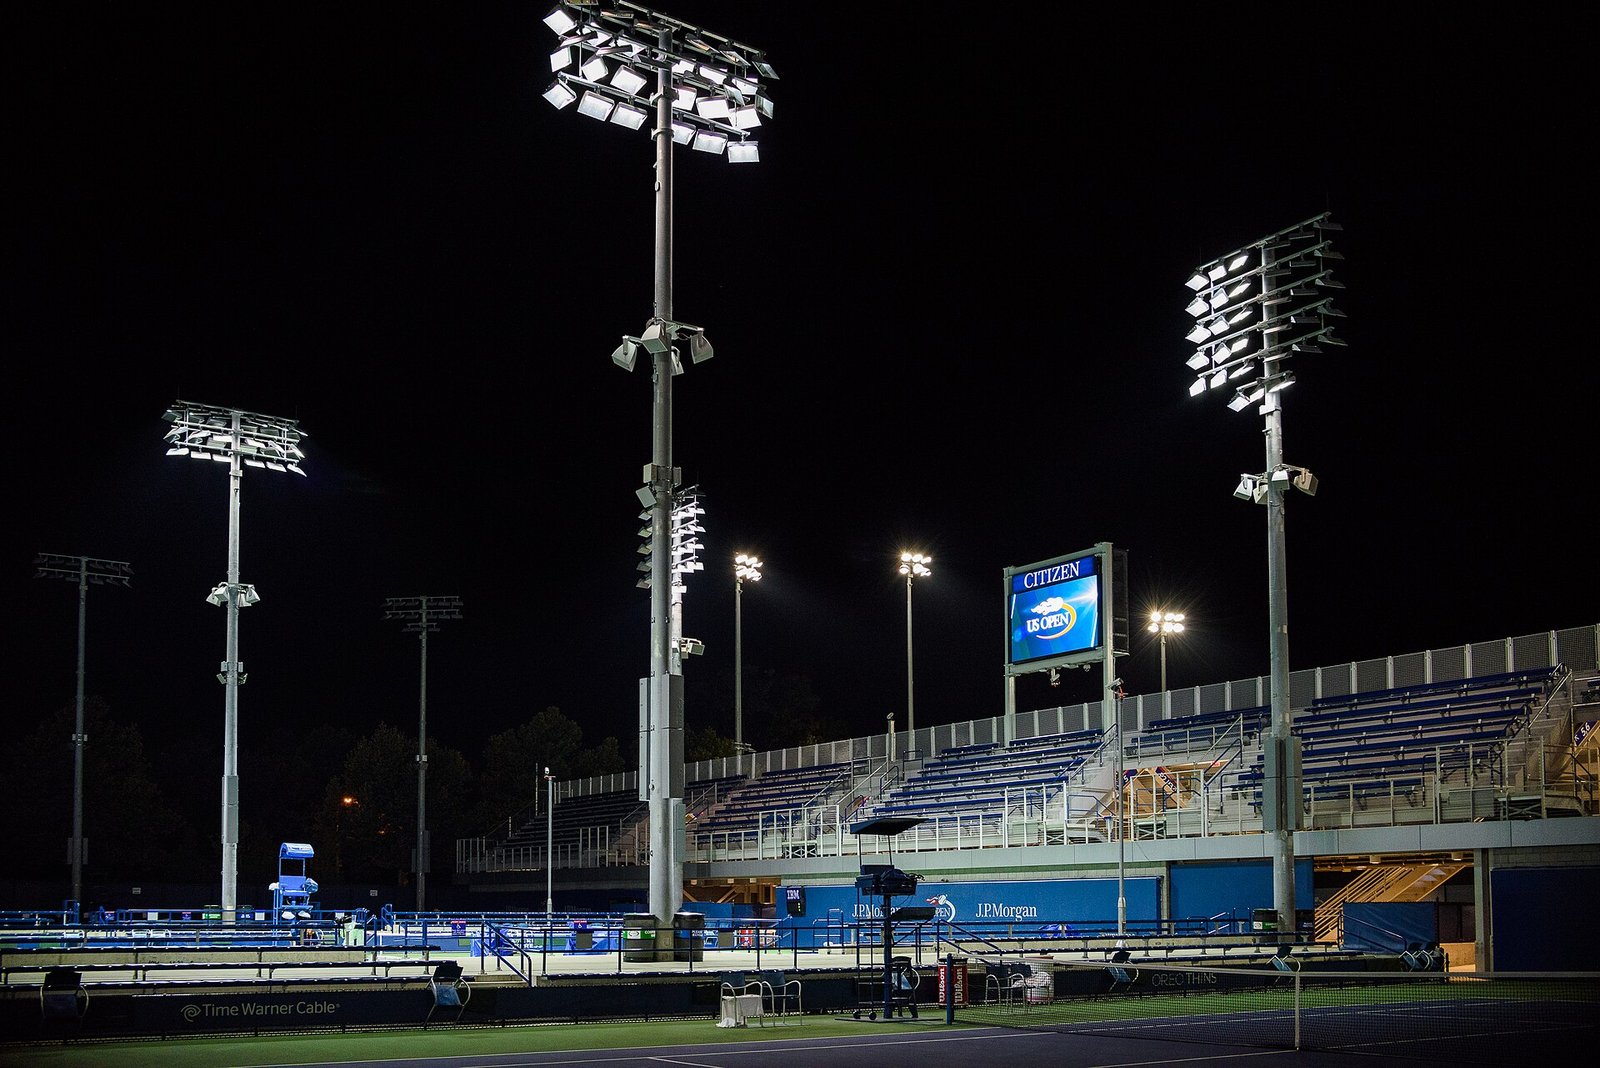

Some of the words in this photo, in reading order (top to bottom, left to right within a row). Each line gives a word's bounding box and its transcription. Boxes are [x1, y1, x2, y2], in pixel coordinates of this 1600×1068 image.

[1024, 561, 1080, 588] CITIZEN
[1026, 618, 1039, 633] US
[1041, 612, 1070, 629] OPEN
[786, 889, 800, 900] IBM
[934, 907, 951, 918] PEN
[976, 903, 1038, 922] J.P.Morgan
[1152, 973, 1184, 987] OREO
[1186, 971, 1217, 984] THINS
[202, 1003, 239, 1017] Time
[241, 1002, 294, 1016] Warner
